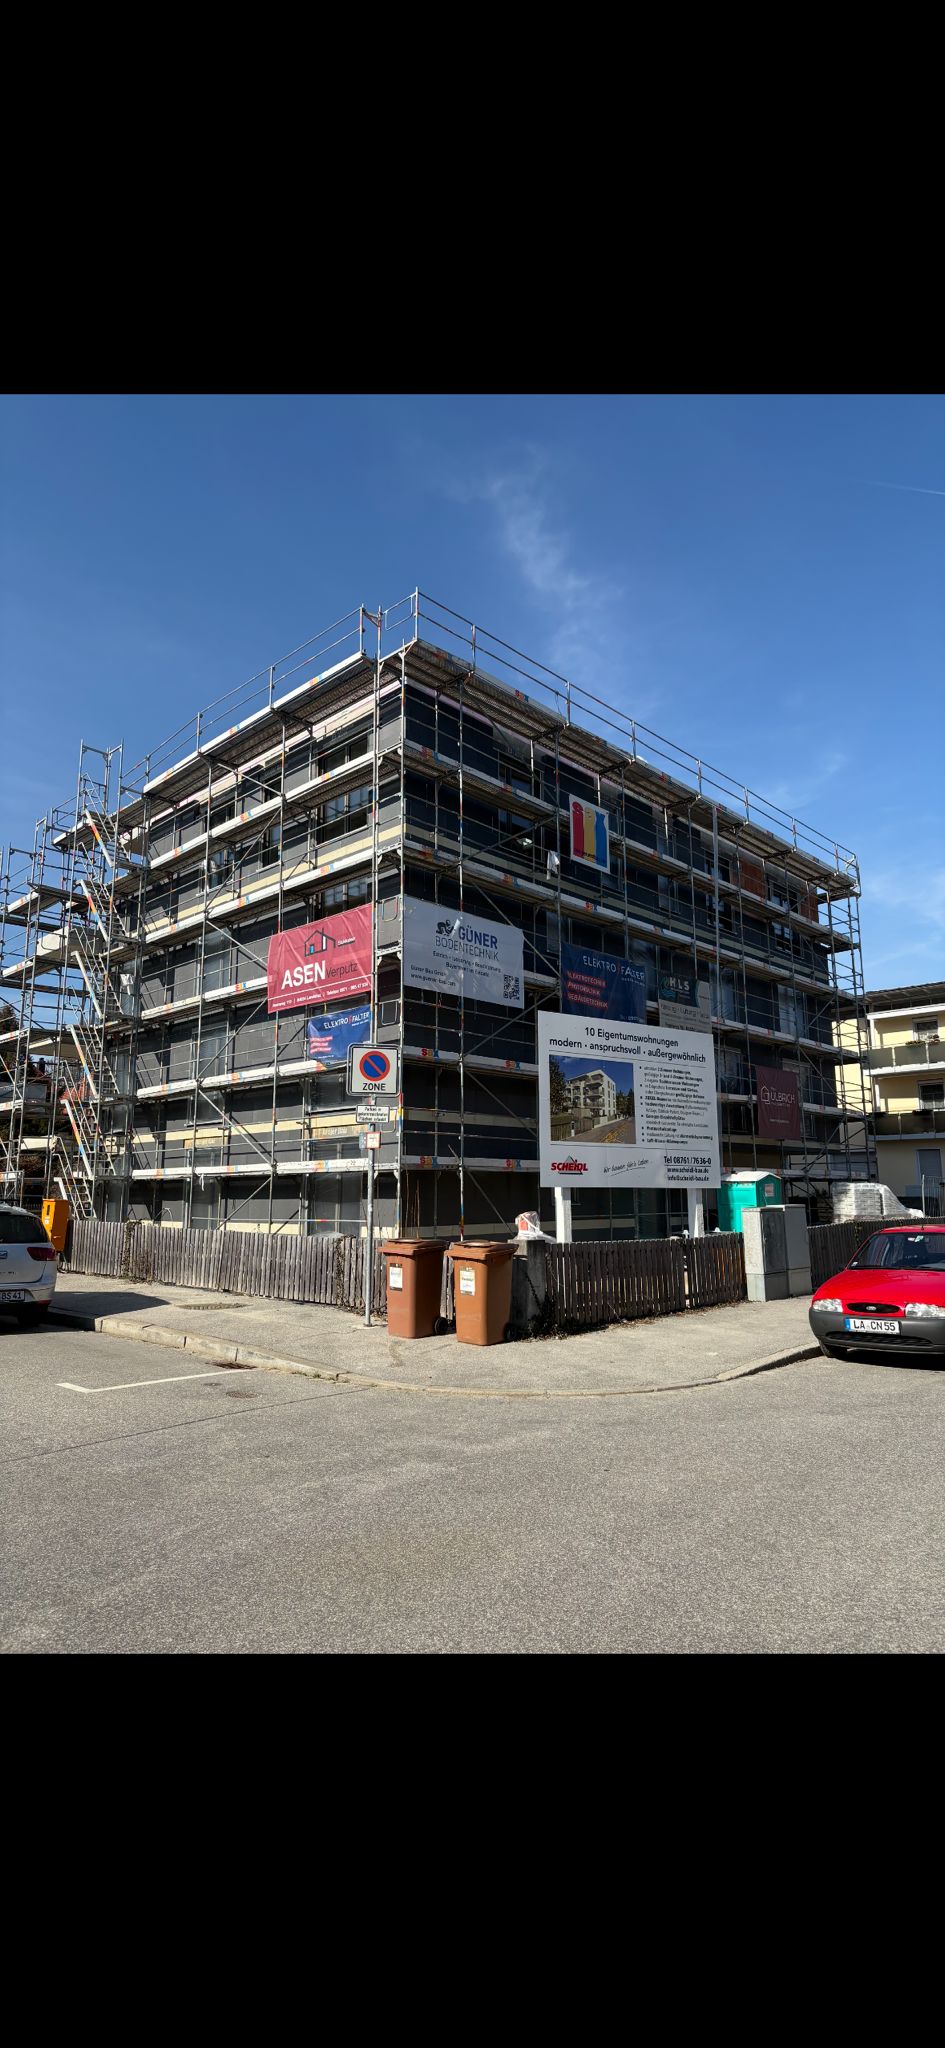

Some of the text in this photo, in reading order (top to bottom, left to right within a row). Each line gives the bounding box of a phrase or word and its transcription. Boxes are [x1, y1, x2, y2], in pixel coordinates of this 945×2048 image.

[458, 925, 498, 949] GÜNER
[435, 936, 499, 961] BODENTECHNIK
[583, 955, 616, 973] ELEKTRO
[281, 960, 358, 990] ASEN Verputz
[323, 1019, 348, 1029] ELEKTRO
[352, 1012, 369, 1021] FALTER
[585, 1027, 678, 1048] 10 Eigentumswohnungen
[550, 1038, 706, 1063] modern anspruchsvoll außergewöhnlich
[362, 1083, 386, 1091] ZONE
[664, 1156, 672, 1164] Tel
[2, 1292, 11, 1300] BS
[853, 1320, 865, 1330] LA
